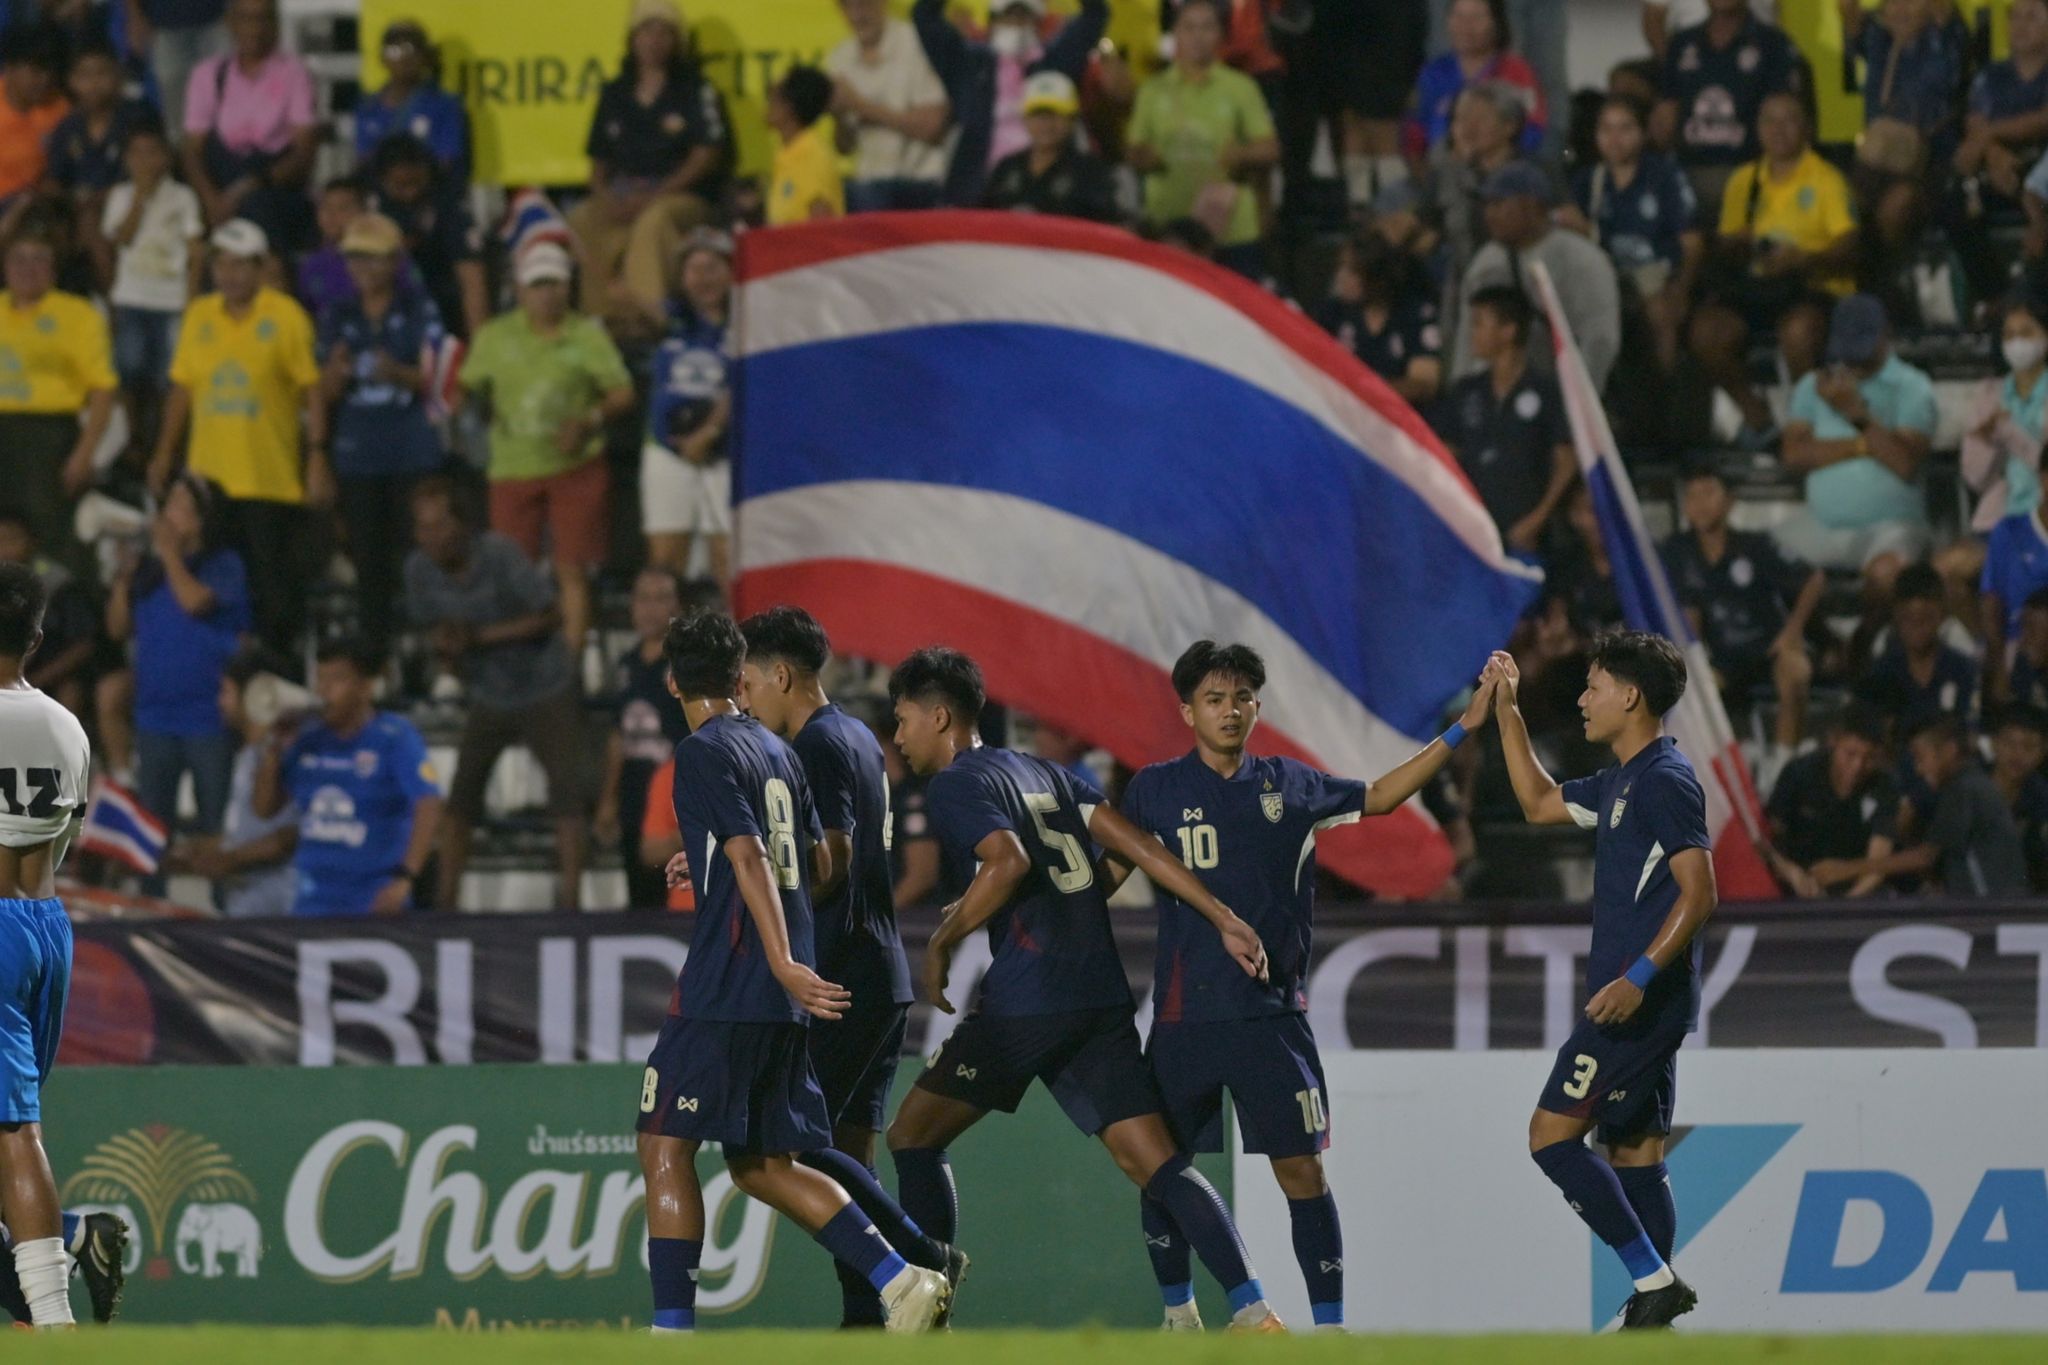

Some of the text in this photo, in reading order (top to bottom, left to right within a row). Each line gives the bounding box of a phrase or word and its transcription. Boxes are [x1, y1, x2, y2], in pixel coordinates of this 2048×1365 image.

[765, 777, 800, 890] 8
[1021, 792, 1094, 894] 5
[1177, 824, 1219, 870] 10
[640, 1066, 659, 1113] 8
[1562, 1053, 1598, 1100] 3
[1295, 1087, 1327, 1134] 10
